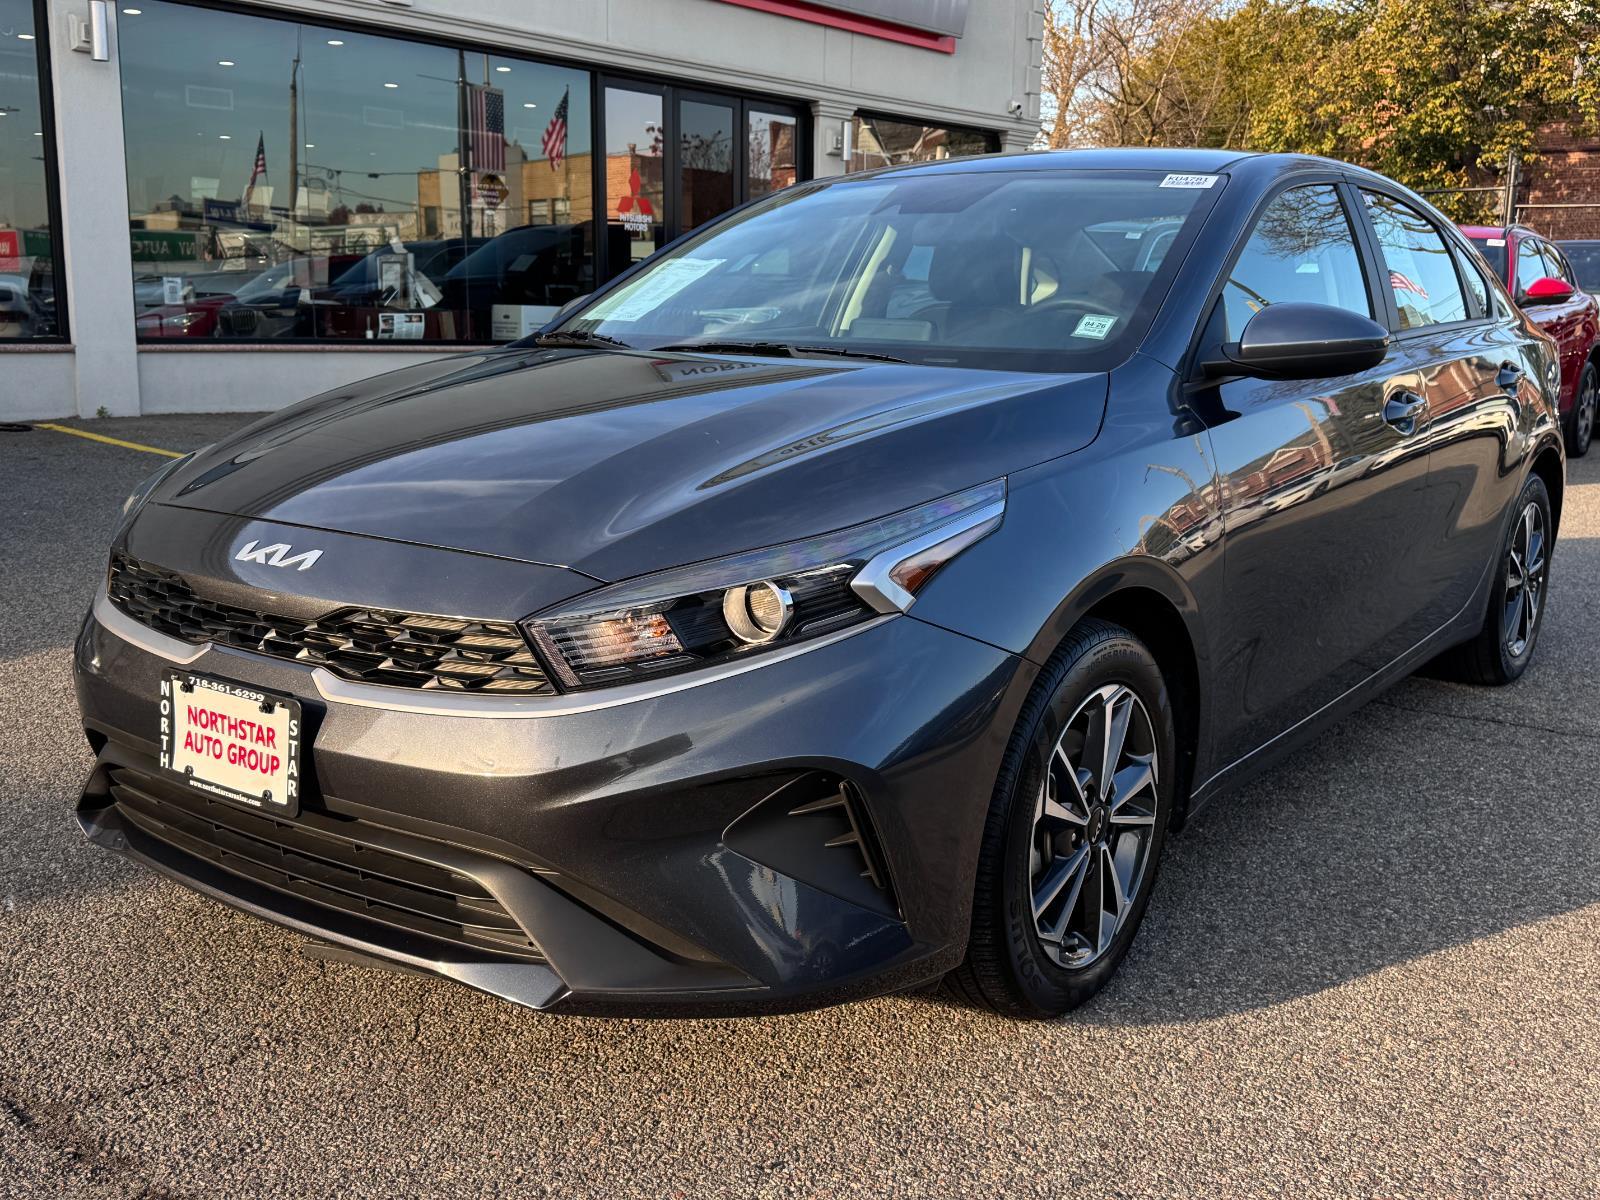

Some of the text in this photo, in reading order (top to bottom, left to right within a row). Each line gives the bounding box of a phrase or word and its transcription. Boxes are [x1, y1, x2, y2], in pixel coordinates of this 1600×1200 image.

[624, 224, 648, 232] MOTORS
[235, 540, 324, 571] KIA
[188, 677, 265, 702] 718-361-6299
[160, 680, 170, 769] NORTH
[187, 705, 277, 750] NORTHSTAR
[184, 730, 280, 776] AUTO GROUP
[287, 719, 298, 797] STAR
